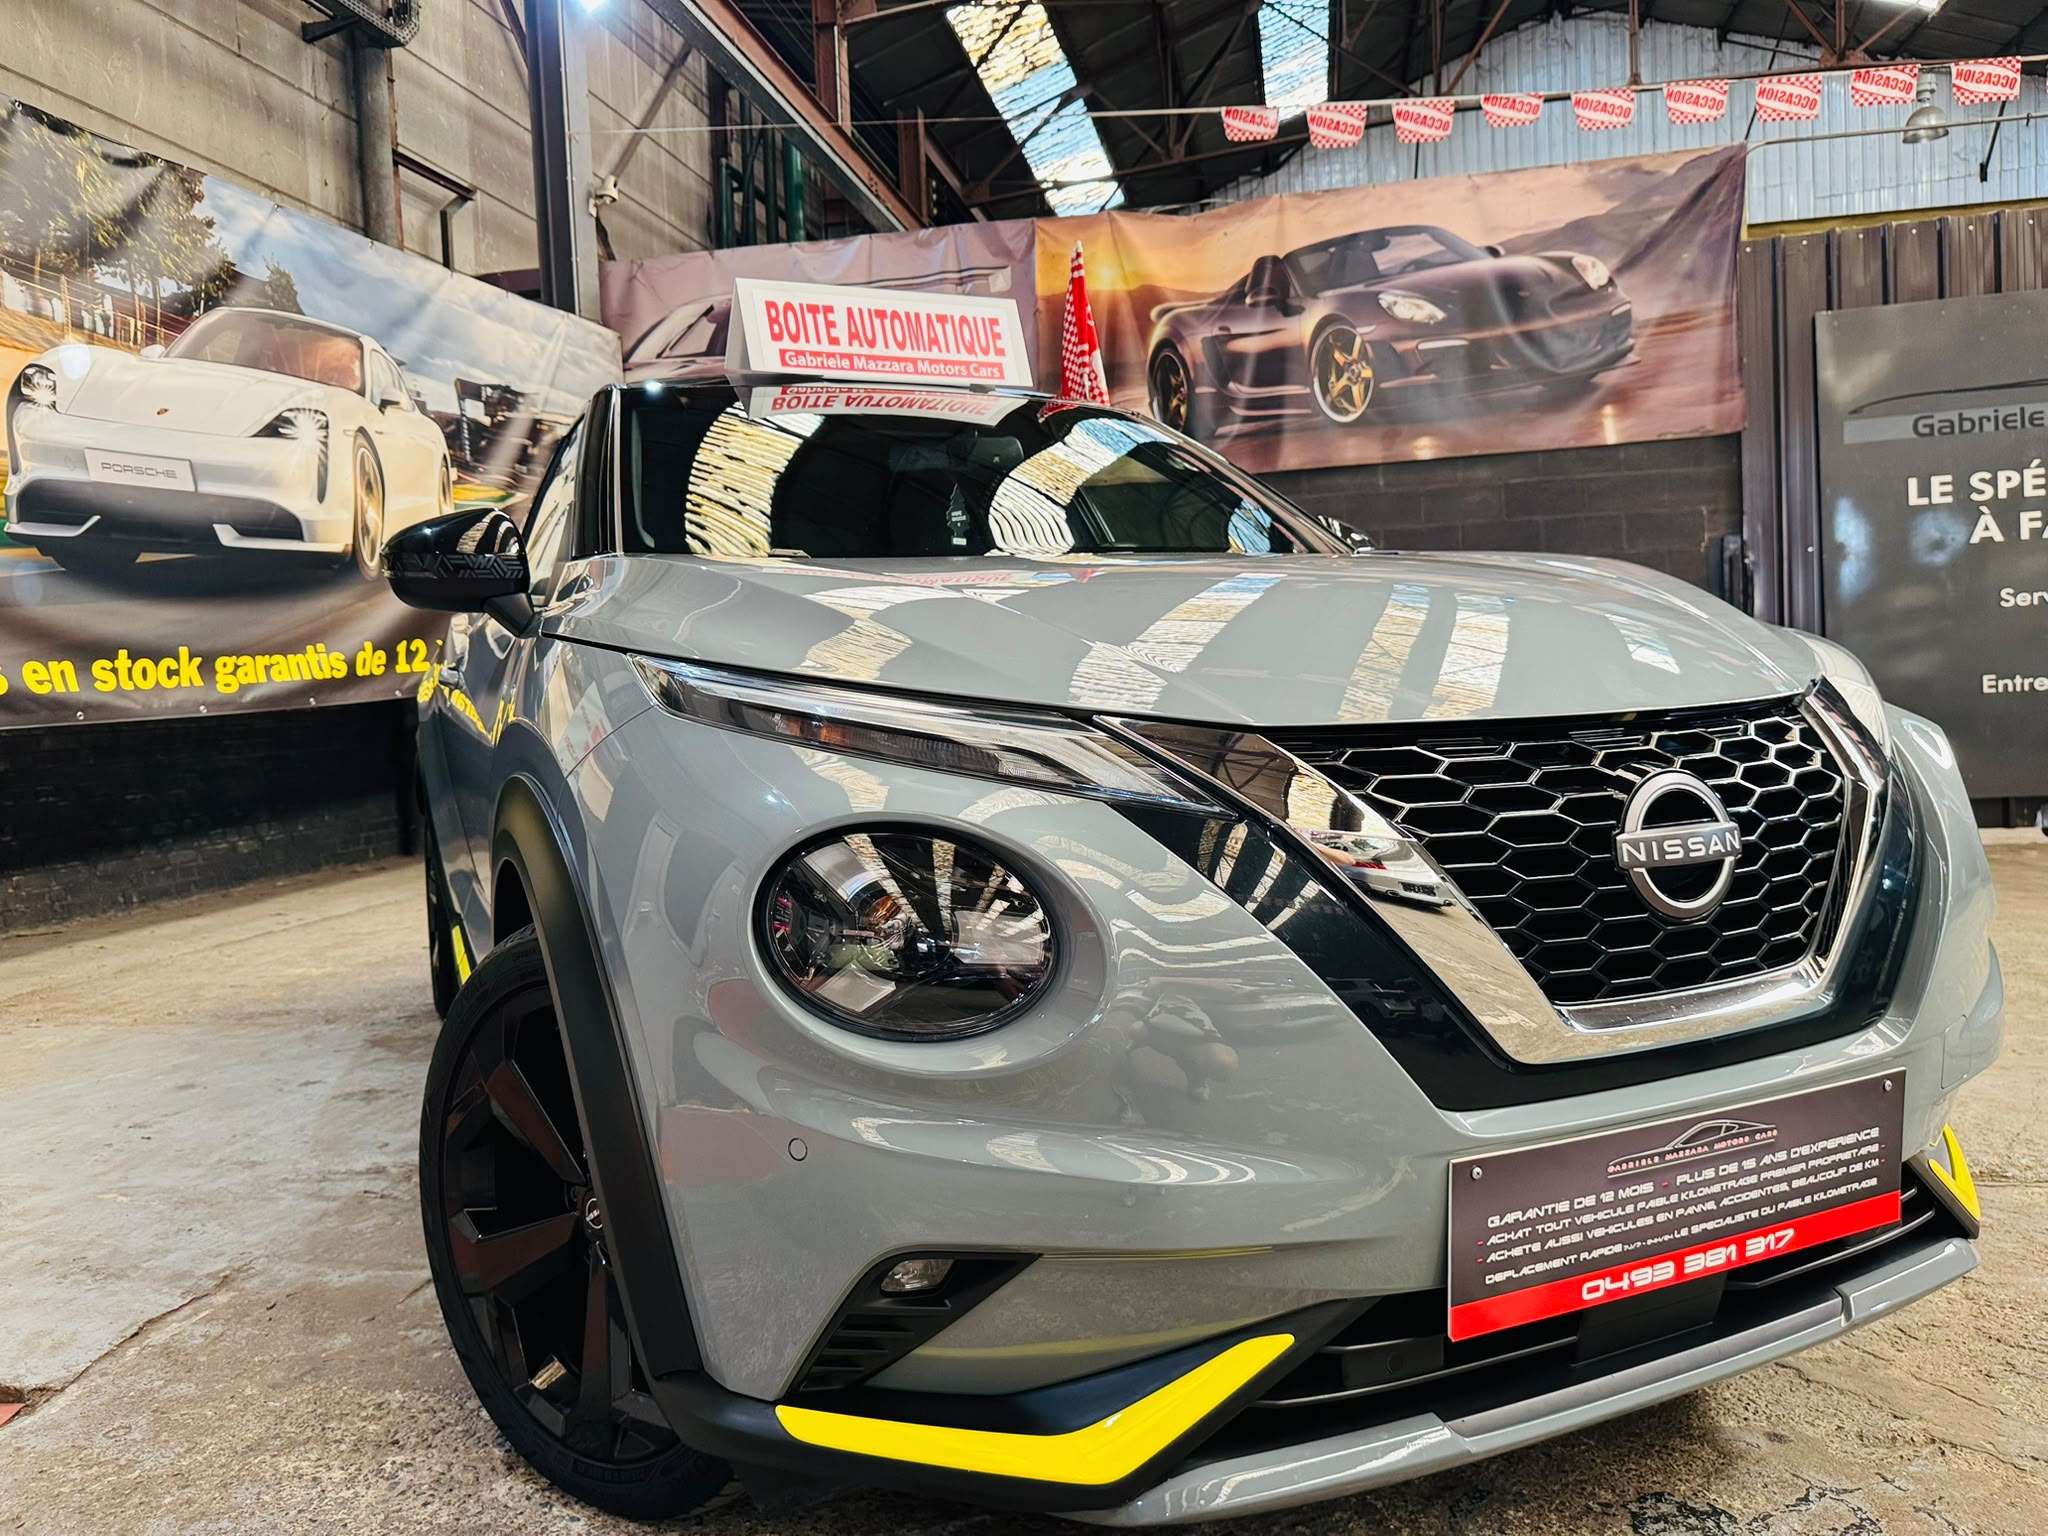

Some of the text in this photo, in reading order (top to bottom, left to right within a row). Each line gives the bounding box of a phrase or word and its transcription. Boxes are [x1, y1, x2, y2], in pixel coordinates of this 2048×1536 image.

[764, 299, 1006, 357] BOITE AUTOMATIQUE
[785, 351, 1000, 379] Gabriele Mazzara Motors Cars
[1912, 406, 2045, 438] Gabriele
[101, 462, 178, 479] PORSCHE
[1907, 458, 2047, 506] LE SPÉ
[1969, 505, 2048, 544] À F
[22, 658, 80, 694] en
[93, 646, 205, 693] stock
[214, 643, 348, 694] garantis
[356, 640, 387, 676] de
[395, 638, 430, 674] 12
[1621, 829, 1740, 862] NISSAN
[1487, 1126, 1880, 1228] GARANTIE DE 12 MOIS PLUS DE 15 ANS D'EXPERIENCE
[1487, 1227, 1532, 1246] ACHAT
[1536, 1218, 1572, 1234] TOUT
[1574, 1203, 1635, 1226] VEHICULE
[1680, 1173, 1759, 1201] KILOMETRAGE
[1760, 1162, 1806, 1182] PREMIER
[1485, 1254, 1578, 1285] DEPLACEMENT
[1579, 1243, 1623, 1262] RAPIDE
[1674, 1226, 1689, 1239] LE
[1690, 1208, 1759, 1235] SPECIALISTE
[1760, 1203, 1776, 1217] DU
[1813, 1176, 1878, 1202] KILOMETRAGE
[1486, 1241, 1542, 1263] ACHETE
[1544, 1232, 1584, 1250] AUSSI
[1586, 1215, 1654, 1239] VEHICULES
[1655, 1210, 1674, 1223] EN
[1791, 1166, 1847, 1190] BEAUCOUP
[1849, 1161, 1863, 1174] DE
[1864, 1157, 1880, 1170] KM
[1581, 1227, 1795, 1301] 0493 381 317
